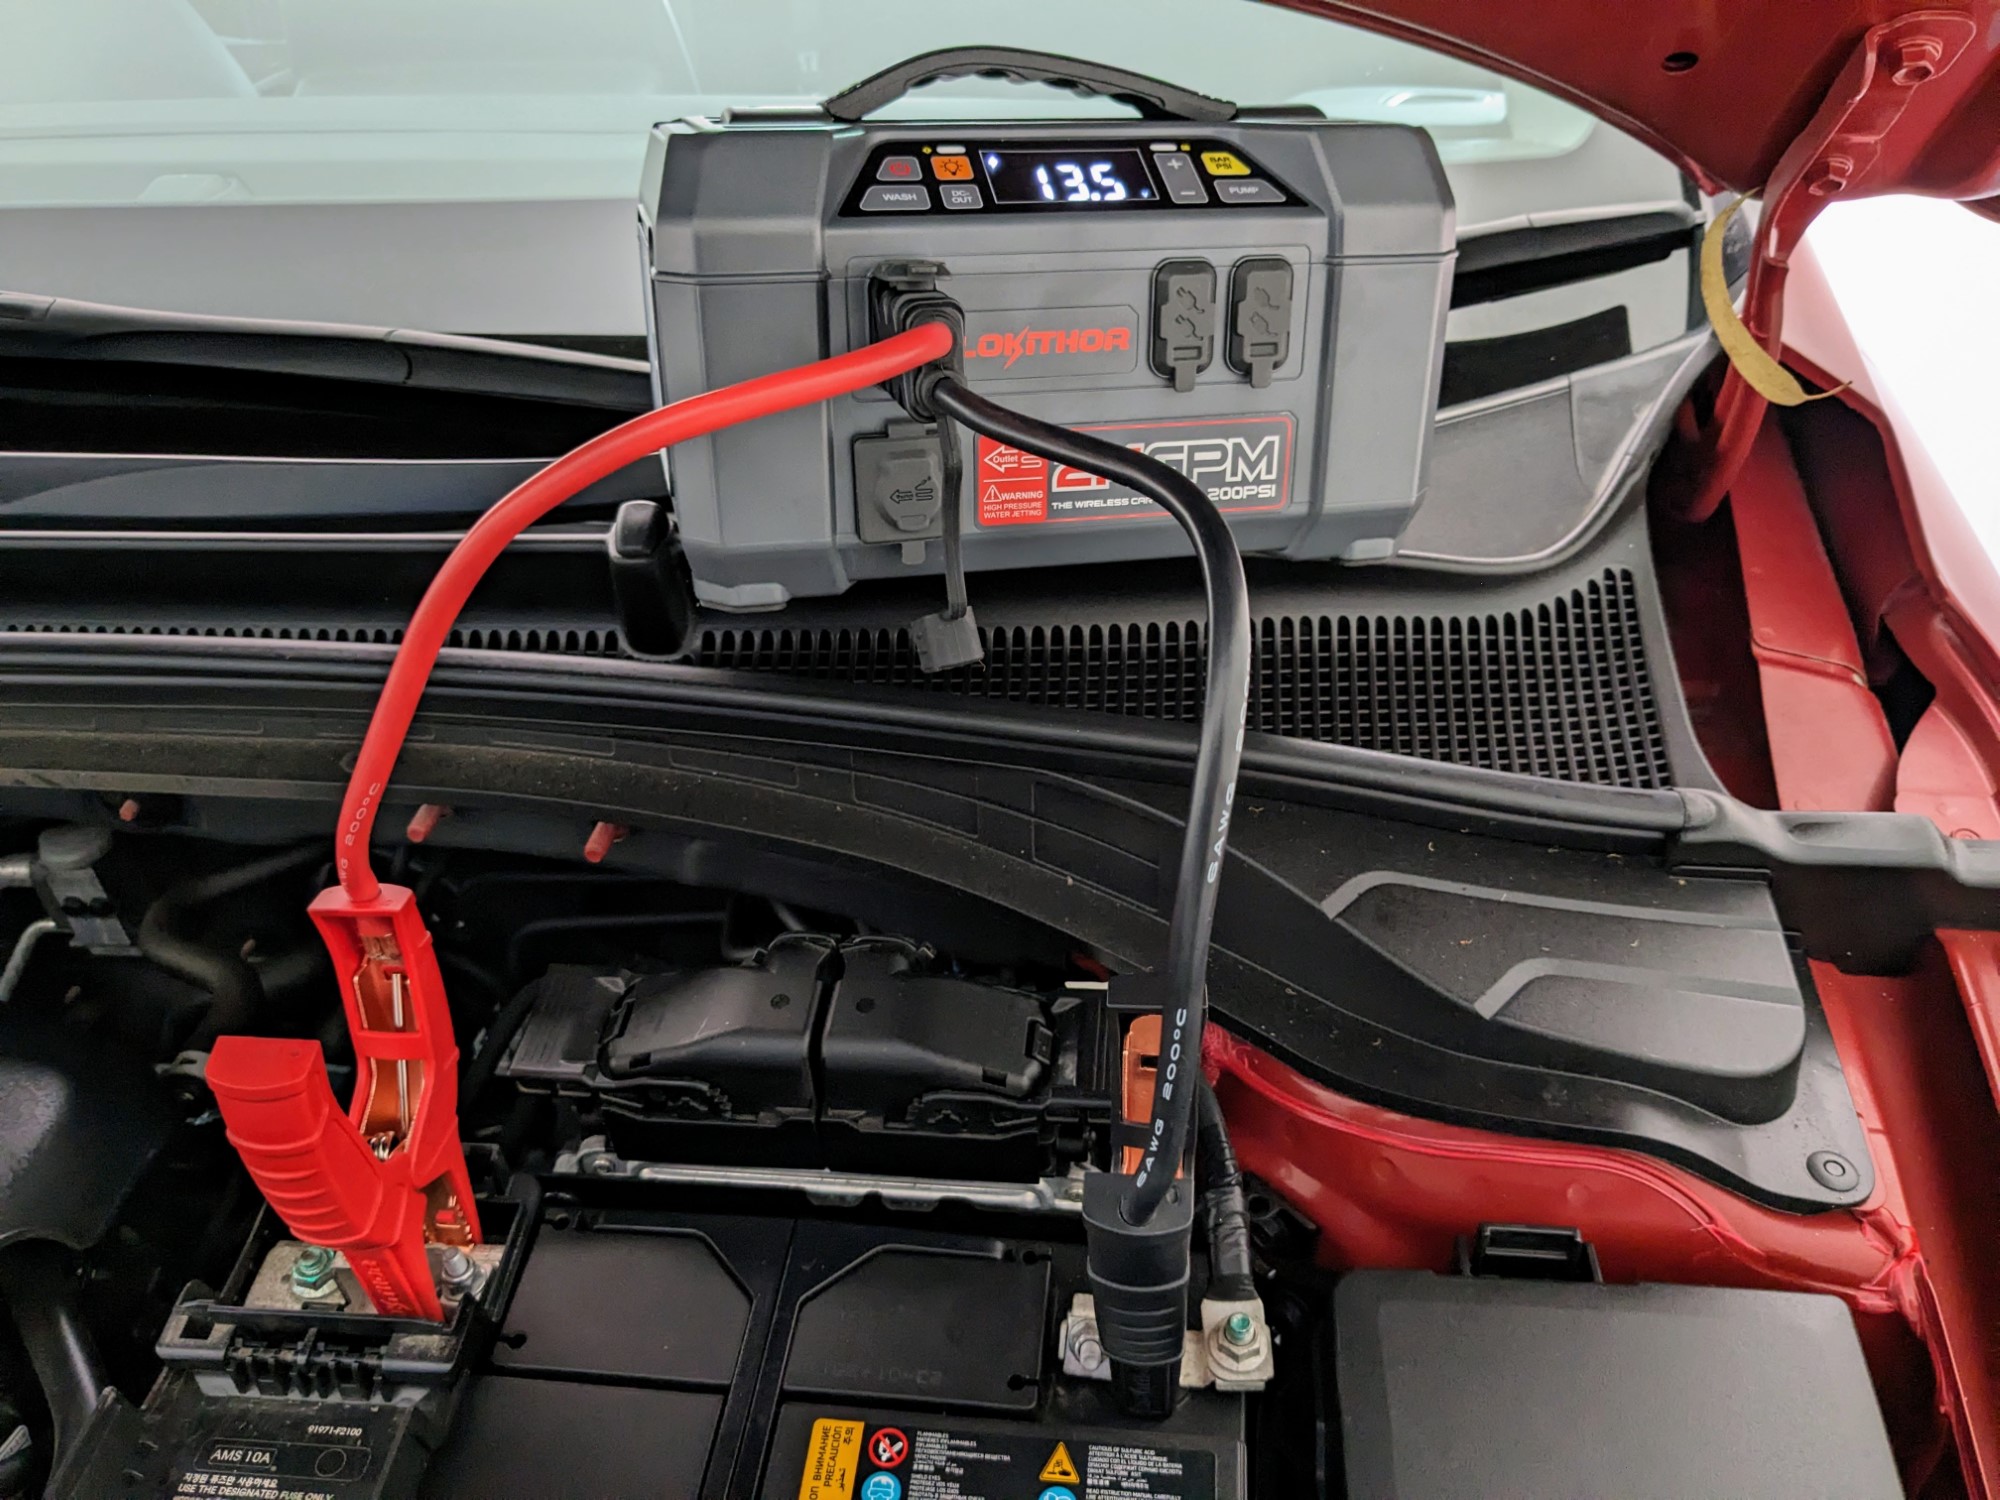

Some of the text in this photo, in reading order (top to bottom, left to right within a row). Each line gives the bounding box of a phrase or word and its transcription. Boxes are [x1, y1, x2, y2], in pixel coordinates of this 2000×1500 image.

[1036, 162, 1126, 201] 13.5
[1228, 186, 1260, 195] PUMP
[882, 192, 918, 202] WASH
[951, 196, 973, 204] OUT
[992, 454, 1019, 464] Outlet
[1001, 490, 1043, 500] WARNING
[1207, 484, 1277, 501] 200PSI
[984, 501, 1043, 511] HIGH PRESSURE
[1051, 501, 1073, 510] THE
[1074, 498, 1129, 509] WIRELESS
[984, 509, 1042, 519] WATER JETTING
[210, 1449, 272, 1464] AMS 10A
[813, 1425, 831, 1481] ВНИМАНИЕ
[177, 1483, 197, 1493] USE
[198, 1485, 218, 1495] THE
[218, 1487, 279, 1499] DESIGNATED
[279, 1490, 305, 1500] FUSE
